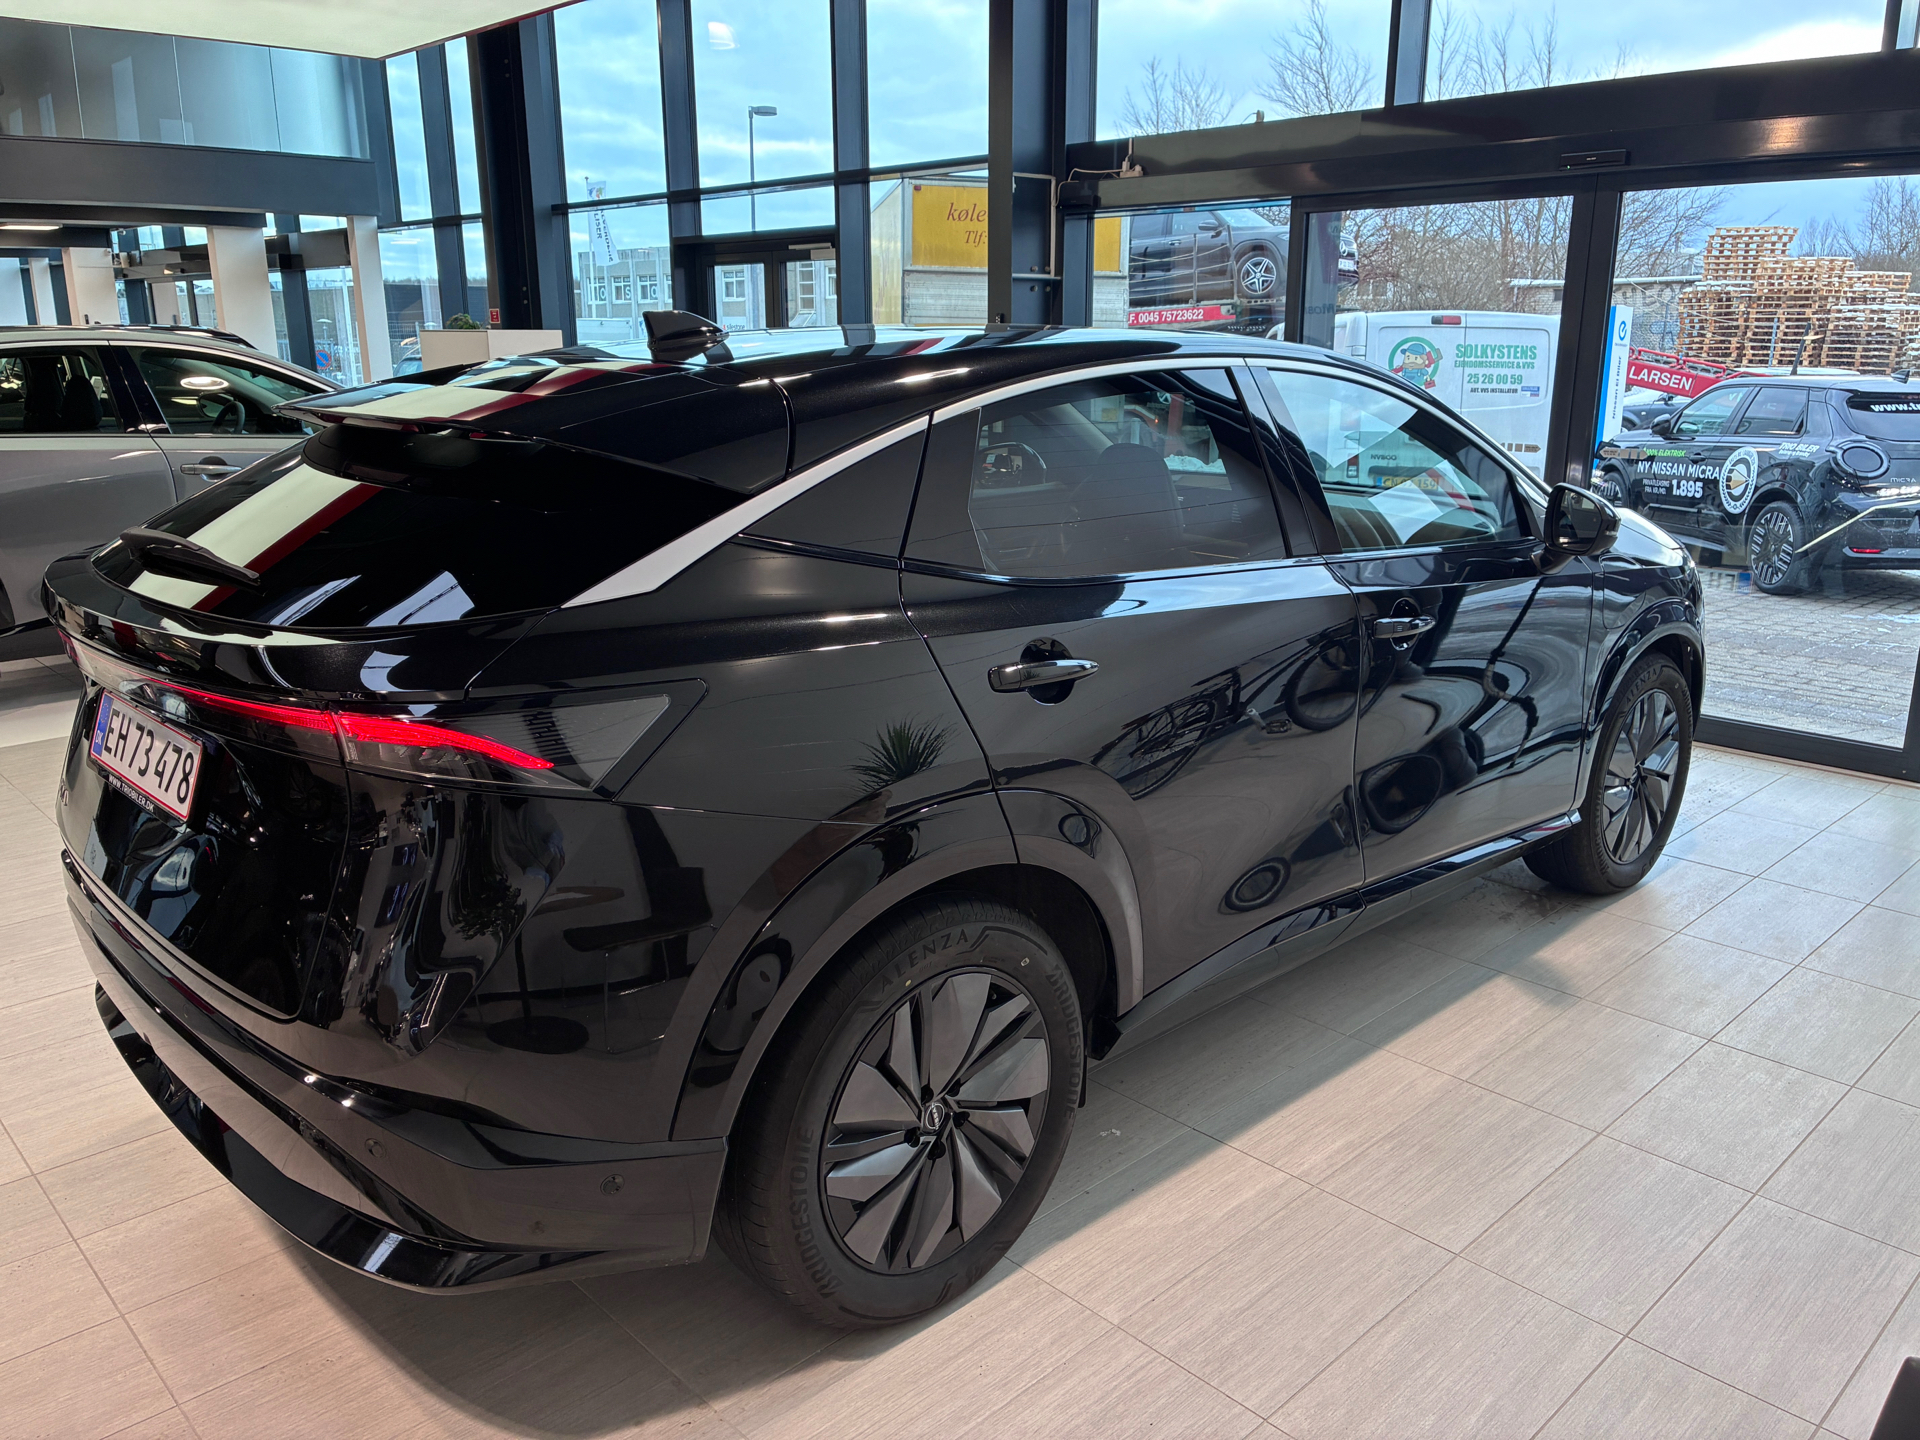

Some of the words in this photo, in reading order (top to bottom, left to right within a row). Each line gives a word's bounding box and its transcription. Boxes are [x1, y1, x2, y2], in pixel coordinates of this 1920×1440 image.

[946, 202, 987, 222] køle
[965, 230, 987, 248] Tlf:
[1138, 312, 1159, 323] 0045
[1161, 308, 1204, 322] 75723622
[1455, 343, 1537, 360] SOLKYSTENS
[1454, 360, 1515, 369] EJENDOMSSERVICE
[1521, 361, 1535, 370] VVS
[1467, 373, 1480, 384] 25
[1480, 373, 1494, 385] 26
[1495, 373, 1509, 385] 00
[1510, 374, 1523, 385] 59
[1629, 366, 1693, 390] LARSEN
[1658, 449, 1687, 457] ELEKTRISK
[1637, 461, 1652, 473] NY
[1651, 461, 1686, 477] NISSAN
[1687, 464, 1720, 480] MICRA
[1417, 479, 1436, 488] 159
[1672, 478, 1704, 499] 1.895
[95, 729, 104, 745] DK
[104, 707, 132, 763] EH
[128, 722, 154, 777] 73
[154, 739, 195, 804] 478
[108, 773, 155, 813] WWW.TRIOBILER.DK
[881, 928, 969, 993] ALENZA
[1046, 962, 1083, 1120] BRIDGESTONE
[788, 1129, 845, 1298] BRIDGESTONE
